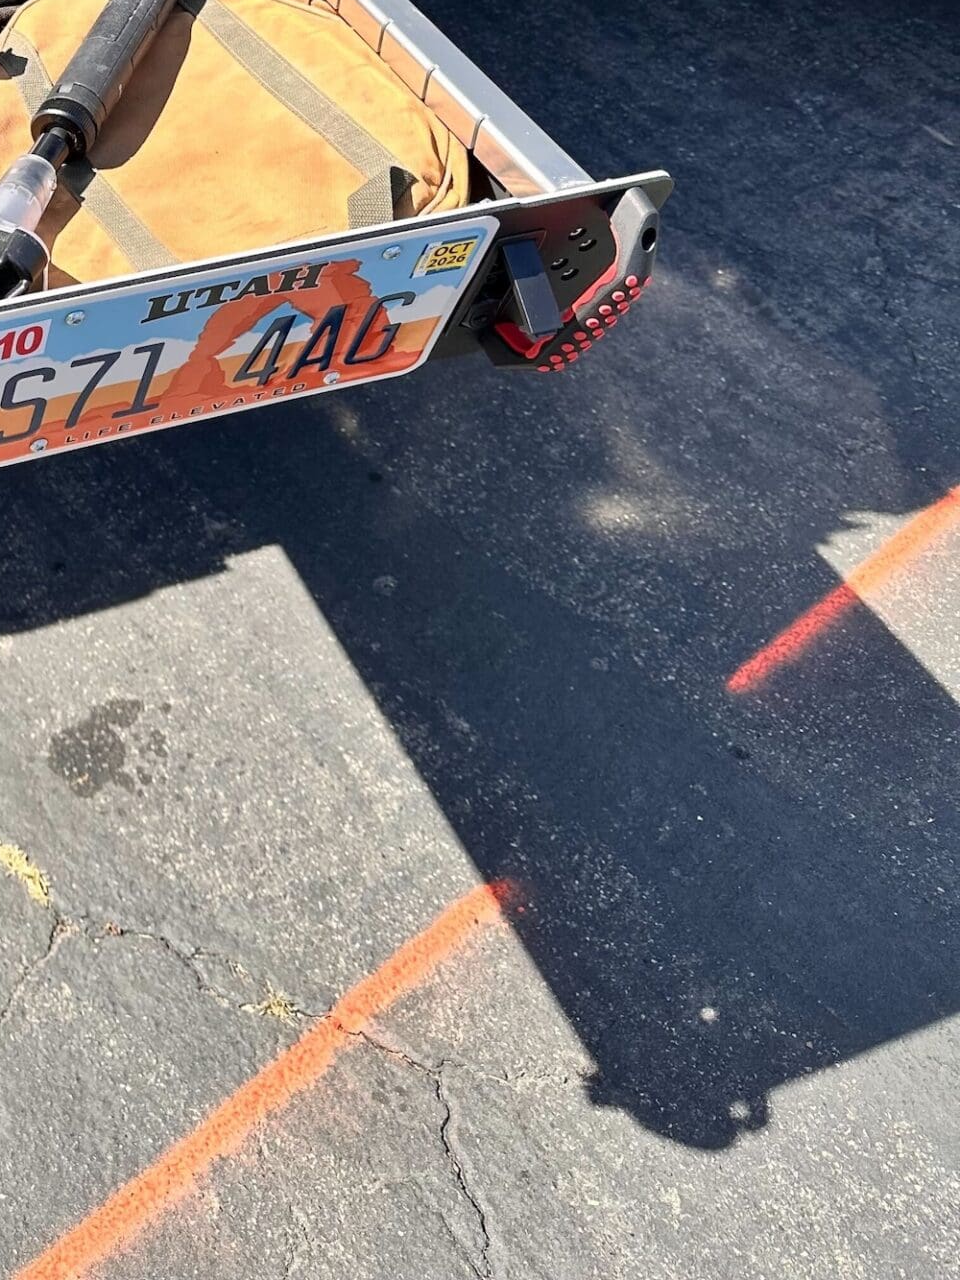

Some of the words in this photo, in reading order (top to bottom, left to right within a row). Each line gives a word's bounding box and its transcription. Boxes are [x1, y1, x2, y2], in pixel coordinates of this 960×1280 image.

[426, 253, 467, 268] 2026
[433, 241, 474, 257] OCT
[140, 261, 330, 324] UTAH
[232, 291, 416, 386] 4AG
[65, 423, 132, 443] LIFE
[150, 383, 306, 425] ELEVATED
